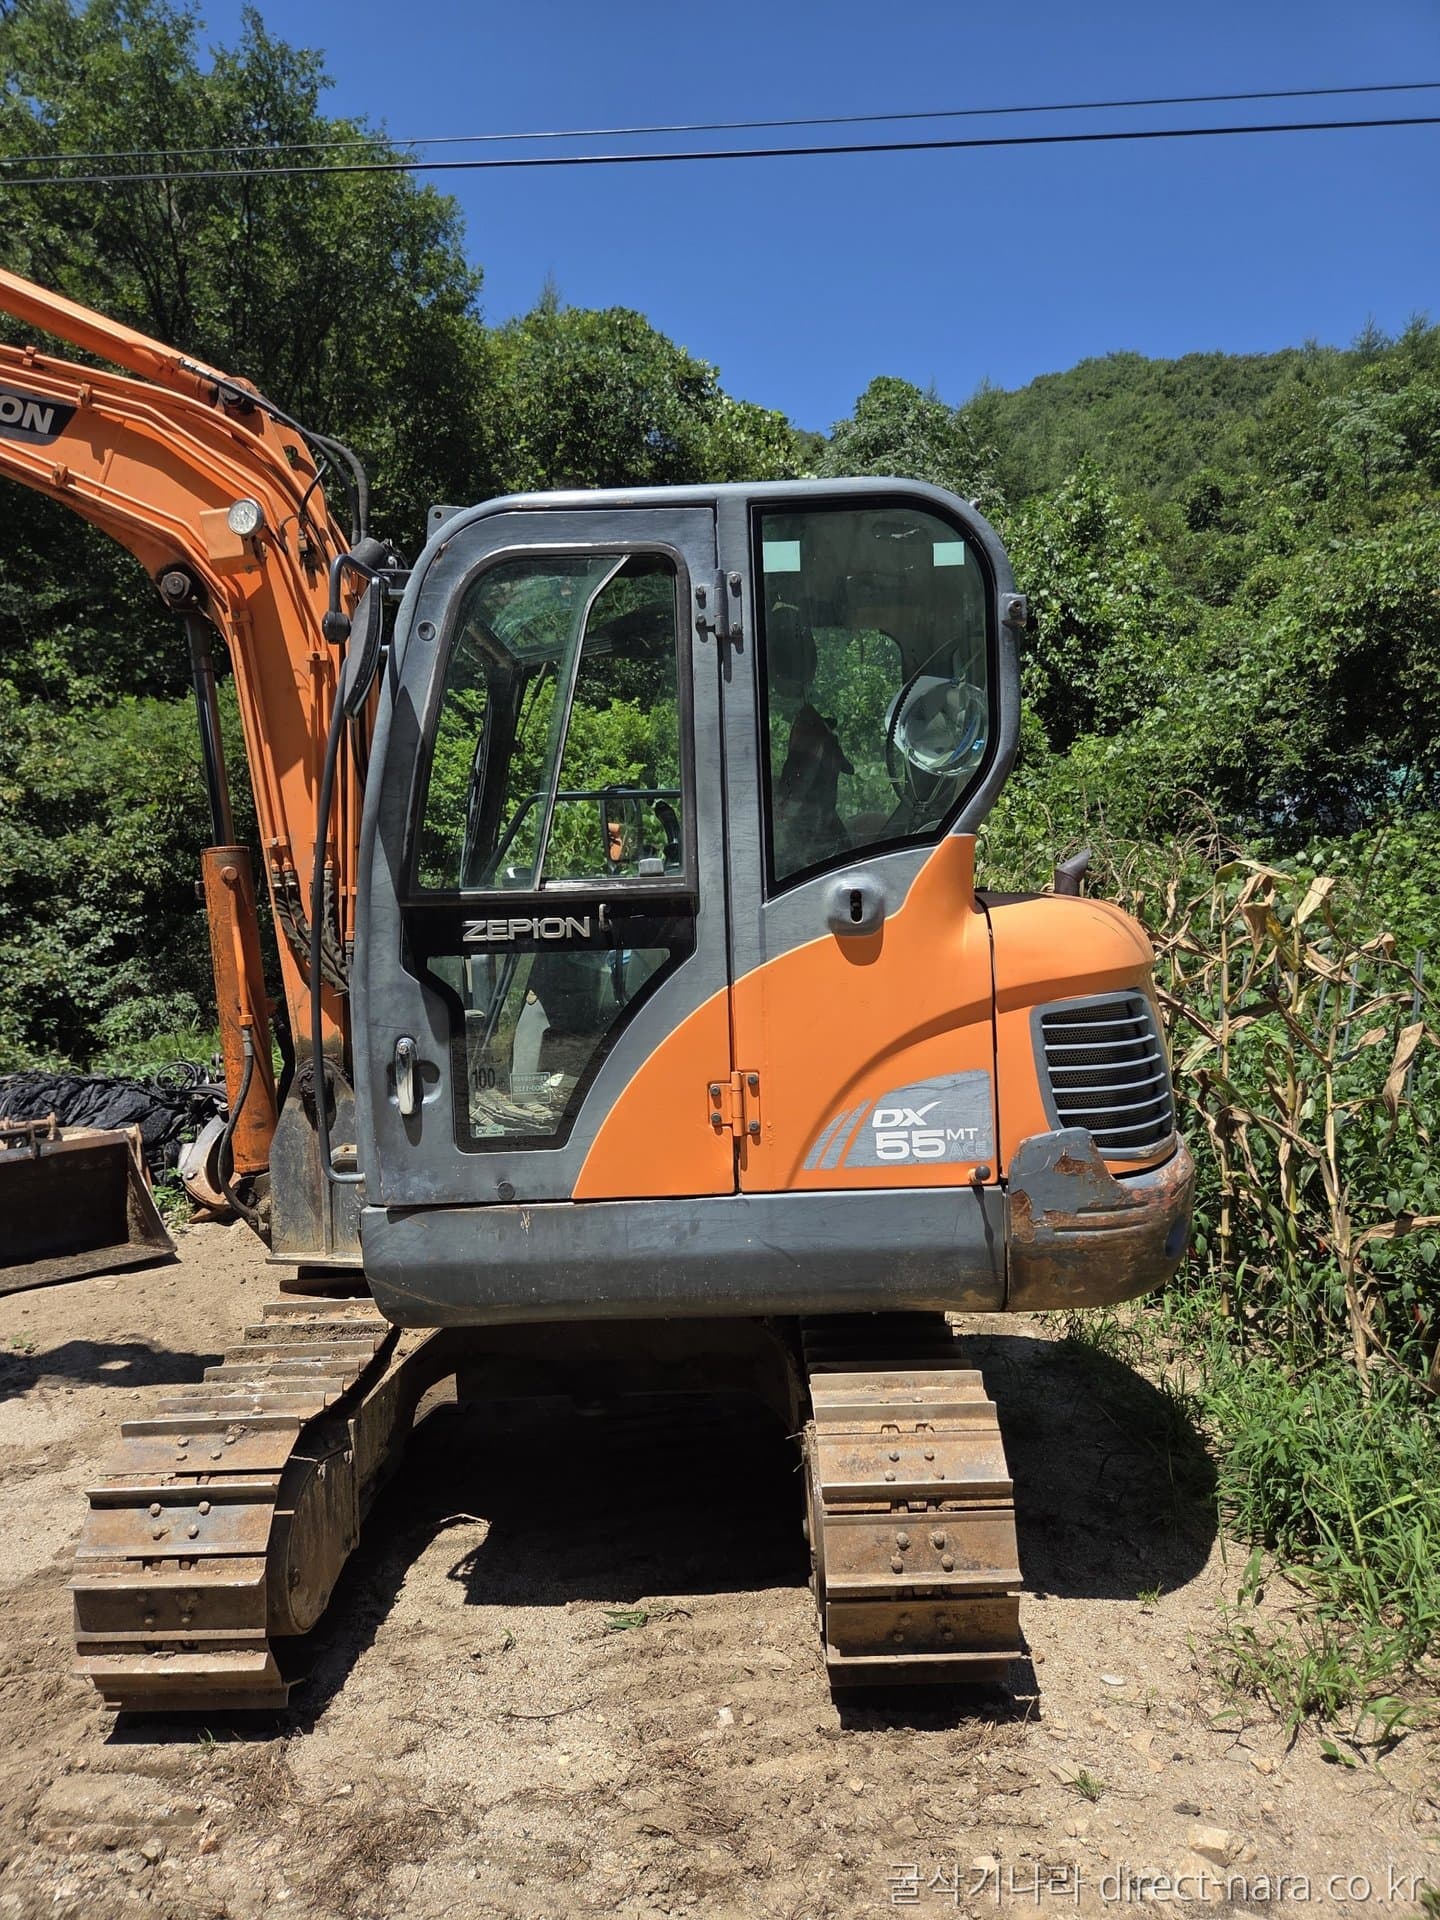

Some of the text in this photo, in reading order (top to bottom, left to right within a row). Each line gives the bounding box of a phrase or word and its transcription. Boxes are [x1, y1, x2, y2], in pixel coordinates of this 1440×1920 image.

[0, 395, 55, 434] ON
[462, 916, 591, 942] ZEPION
[472, 1067, 496, 1089] 100
[872, 1100, 943, 1128] DX
[875, 1127, 979, 1160] 55 MT
